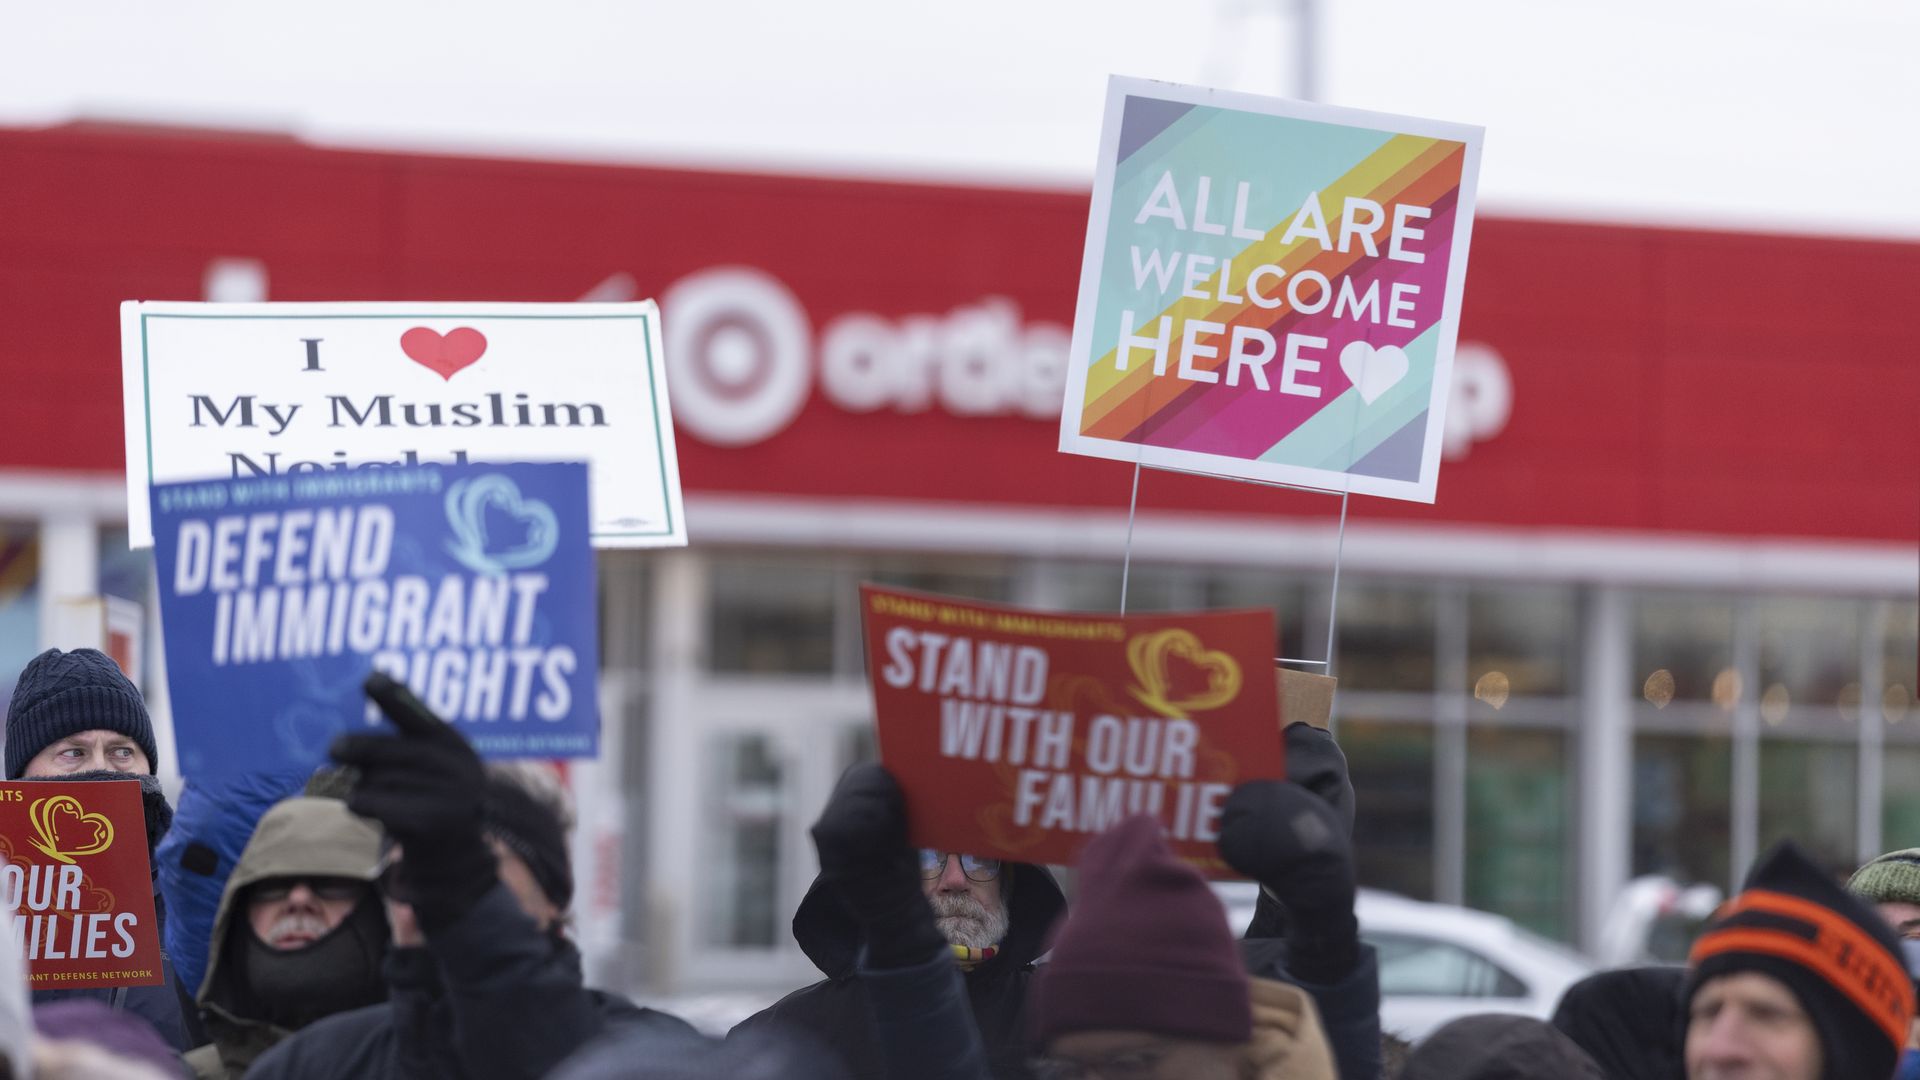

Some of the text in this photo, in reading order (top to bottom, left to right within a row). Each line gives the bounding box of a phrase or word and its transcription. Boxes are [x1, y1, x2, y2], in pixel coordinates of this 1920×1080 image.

[1134, 169, 1432, 264] ALL ARE
[1130, 245, 1421, 329] WELCOME
[300, 338, 326, 372] I
[820, 297, 1072, 418] orde
[1115, 310, 1329, 398] HERE
[188, 393, 610, 436] My Muslim
[174, 505, 396, 597] DEFEND
[212, 574, 548, 665] IMMIGRANT
[882, 626, 1049, 706] STAND
[940, 699, 1199, 779] WITH OUR
[1013, 770, 1231, 843] FAMILIE
[2, 864, 83, 911] OUR
[12, 912, 138, 960] ILIES
[53, 971, 98, 981] DEFENSE
[101, 969, 153, 979] NETWORK
